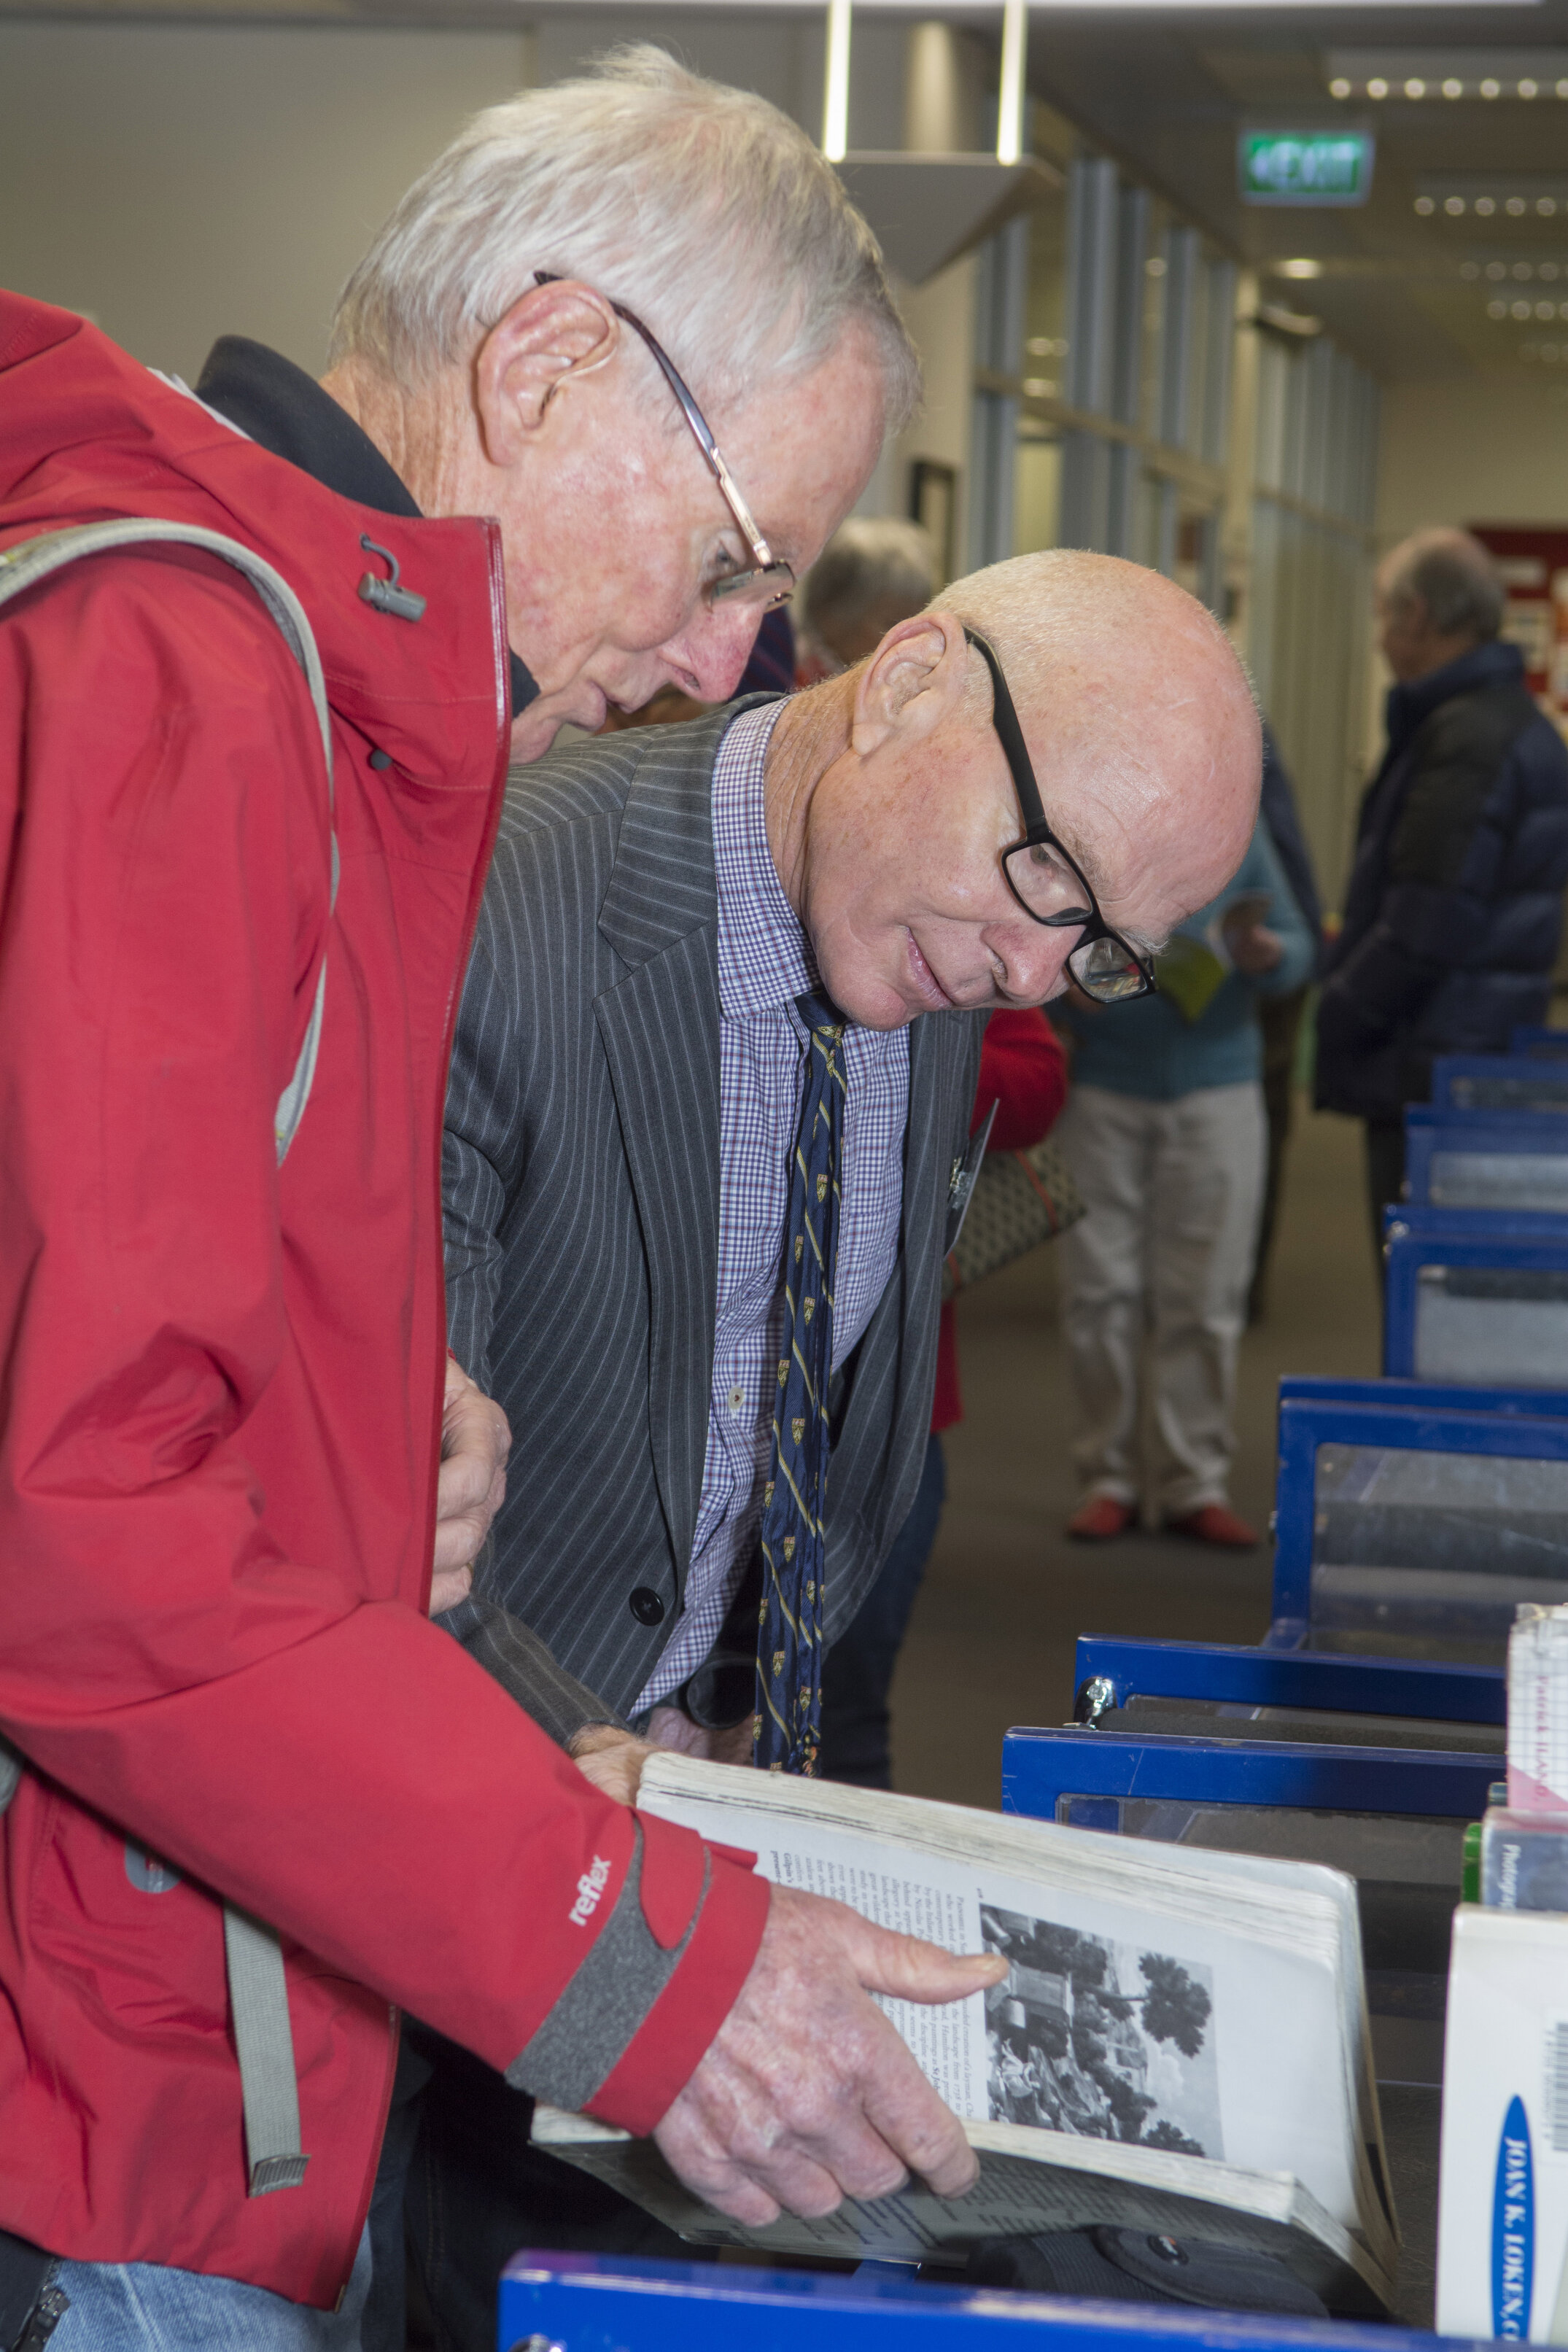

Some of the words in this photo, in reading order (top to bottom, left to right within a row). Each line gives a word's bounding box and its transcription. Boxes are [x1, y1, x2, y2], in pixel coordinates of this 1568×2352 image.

[783, 1852, 794, 1883] Gilpin's
[568, 1854, 612, 1927] reflex
[881, 1875, 890, 1910] landscape
[891, 1878, 900, 1908] allegory
[935, 1890, 944, 1942] contemporary
[942, 2025, 950, 2060] Hamilton
[920, 2007, 928, 2019] the
[951, 2008, 959, 2020] the
[920, 2022, 928, 2057] discipline
[929, 2022, 938, 2058] paintings
[951, 2023, 960, 2060] landscape
[1505, 2135, 1528, 2201] JOAN
[1504, 2203, 1526, 2229] K.
